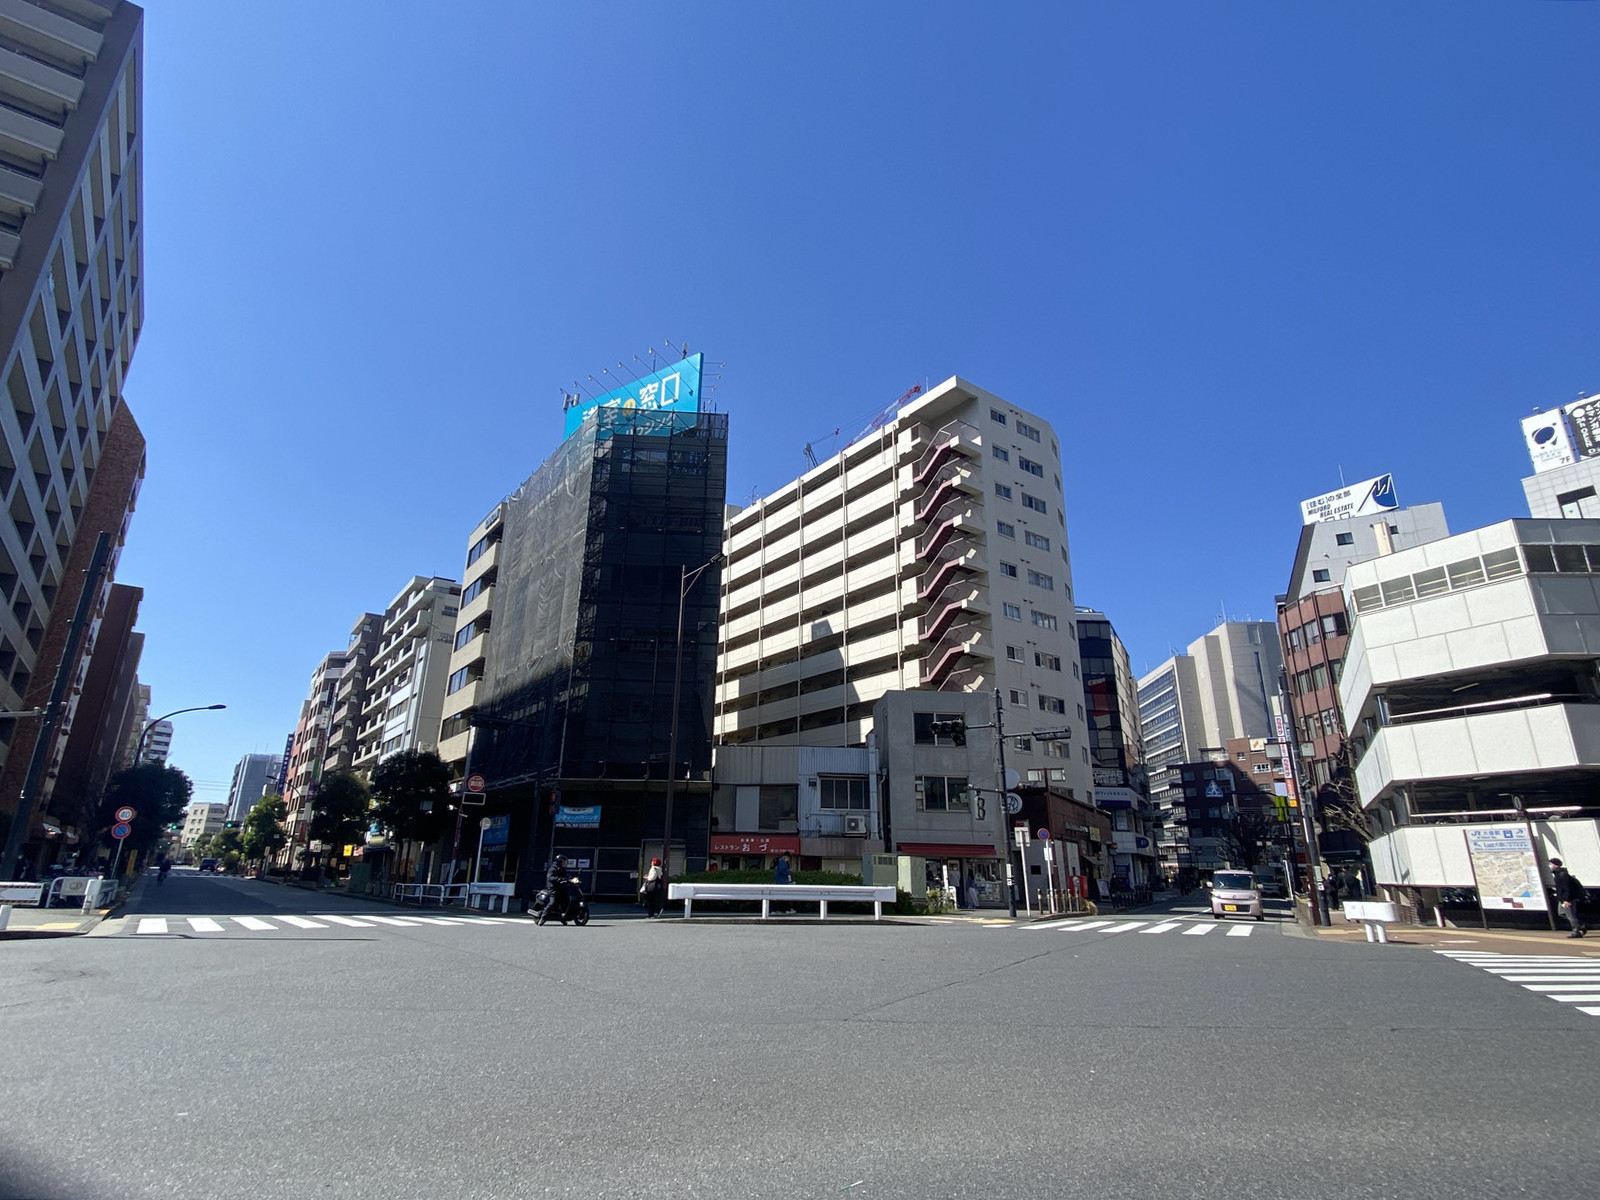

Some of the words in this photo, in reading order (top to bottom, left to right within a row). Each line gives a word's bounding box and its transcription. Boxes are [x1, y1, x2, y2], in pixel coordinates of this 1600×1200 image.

[1559, 455, 1571, 464] 7F
[1307, 504, 1331, 516] MILFORD
[1319, 510, 1333, 518] REAL
[1334, 502, 1354, 514] ESTATE
